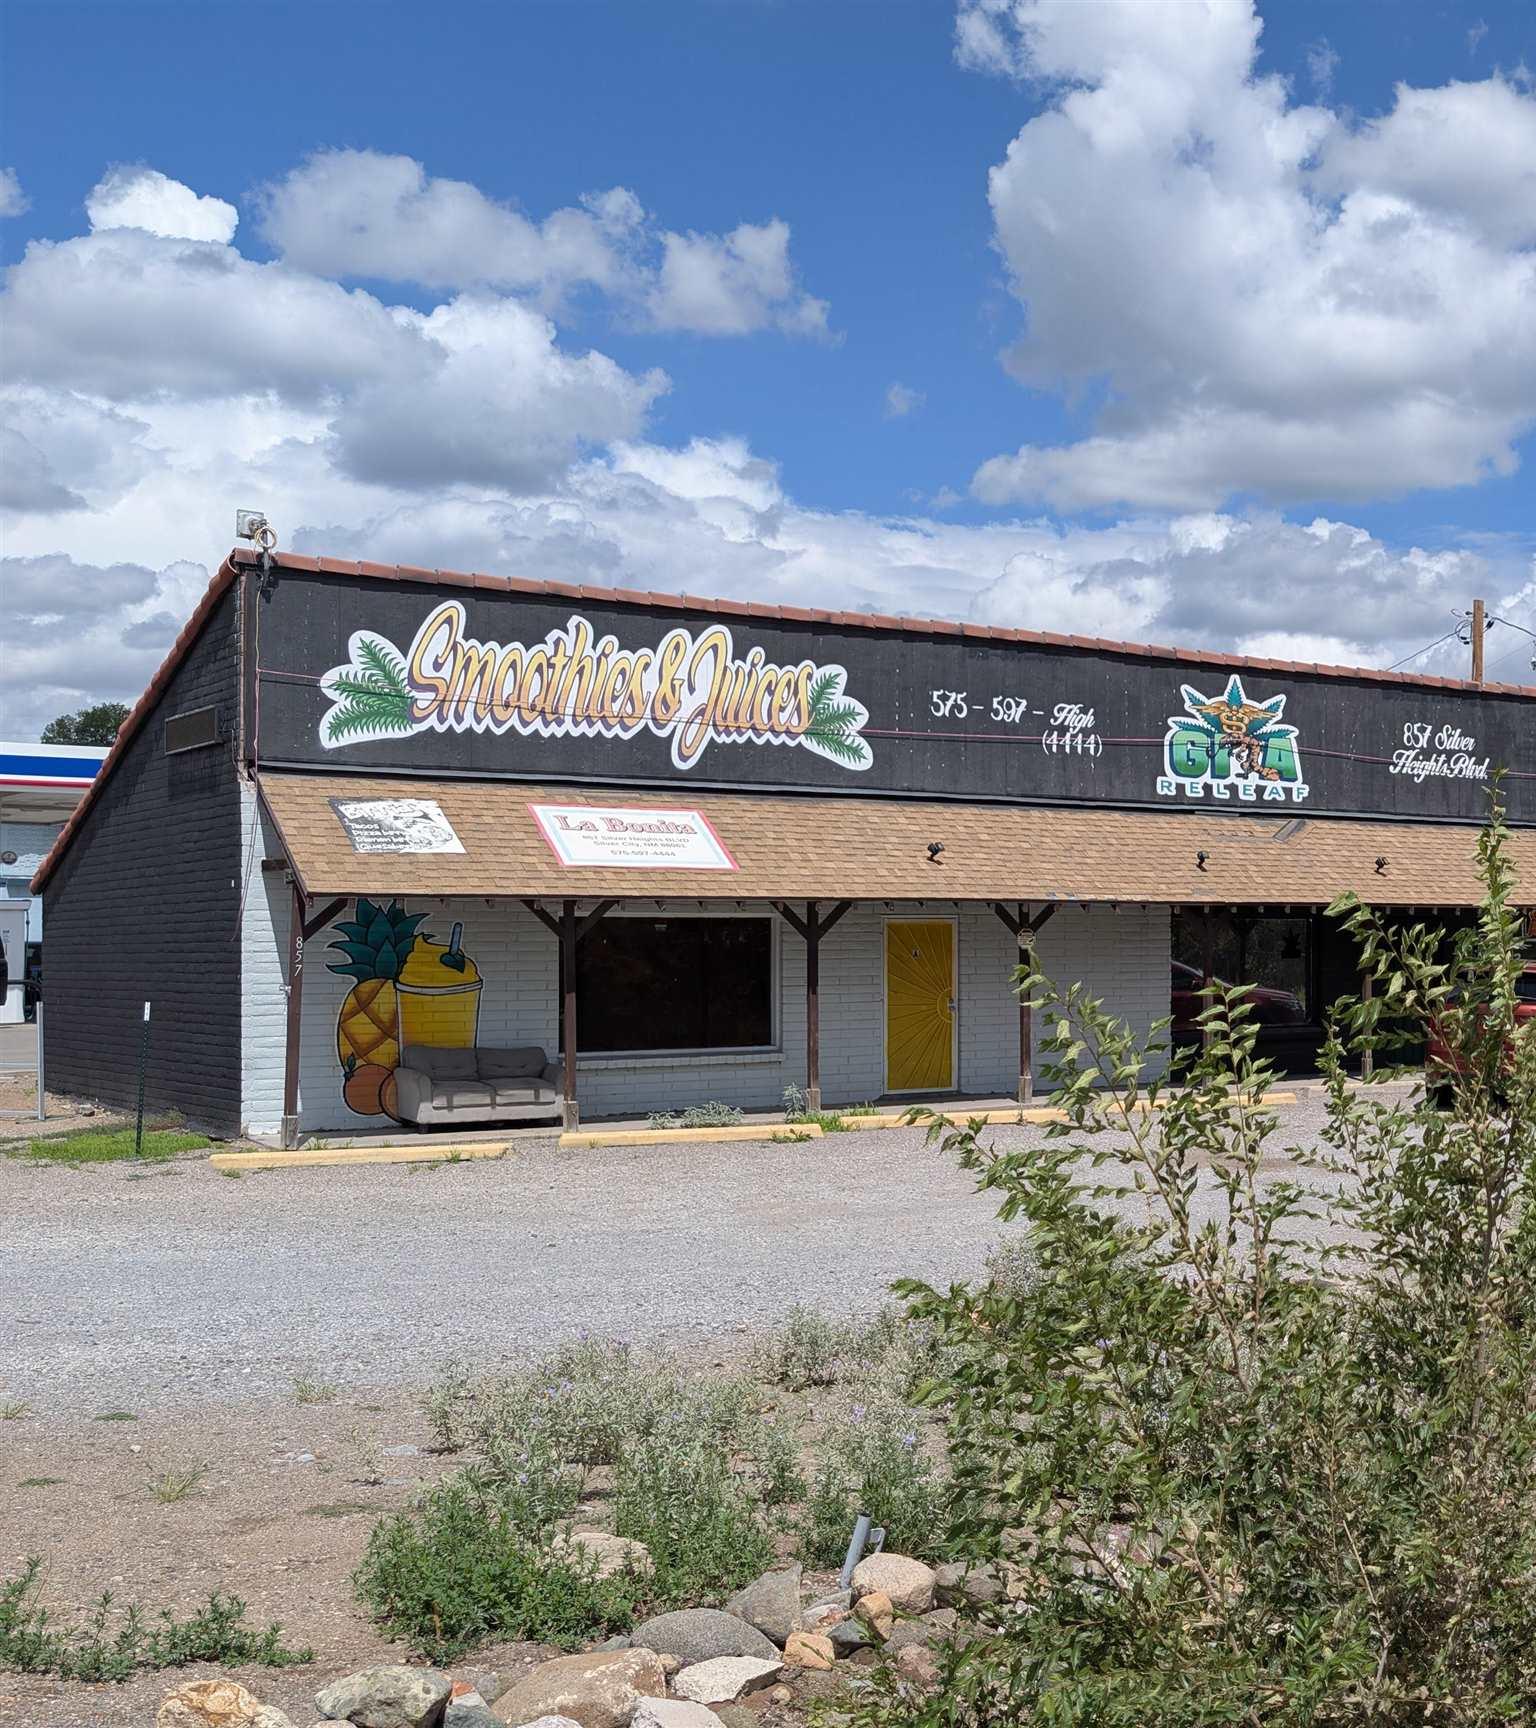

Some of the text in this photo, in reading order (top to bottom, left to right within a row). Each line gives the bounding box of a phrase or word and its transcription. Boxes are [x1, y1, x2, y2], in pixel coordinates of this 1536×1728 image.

[408, 606, 815, 762] Smoothies & Juices
[931, 689, 968, 718] 575
[990, 696, 1027, 723] 597
[1050, 703, 1095, 734] High
[1042, 730, 1102, 757] (4444)
[1403, 722, 1476, 751] 857 Silver
[1389, 749, 1490, 783] Heights Blvd.
[1160, 780, 1306, 800] RELEAF
[554, 815, 697, 834] La Bonita
[295, 936, 303, 976] 857
